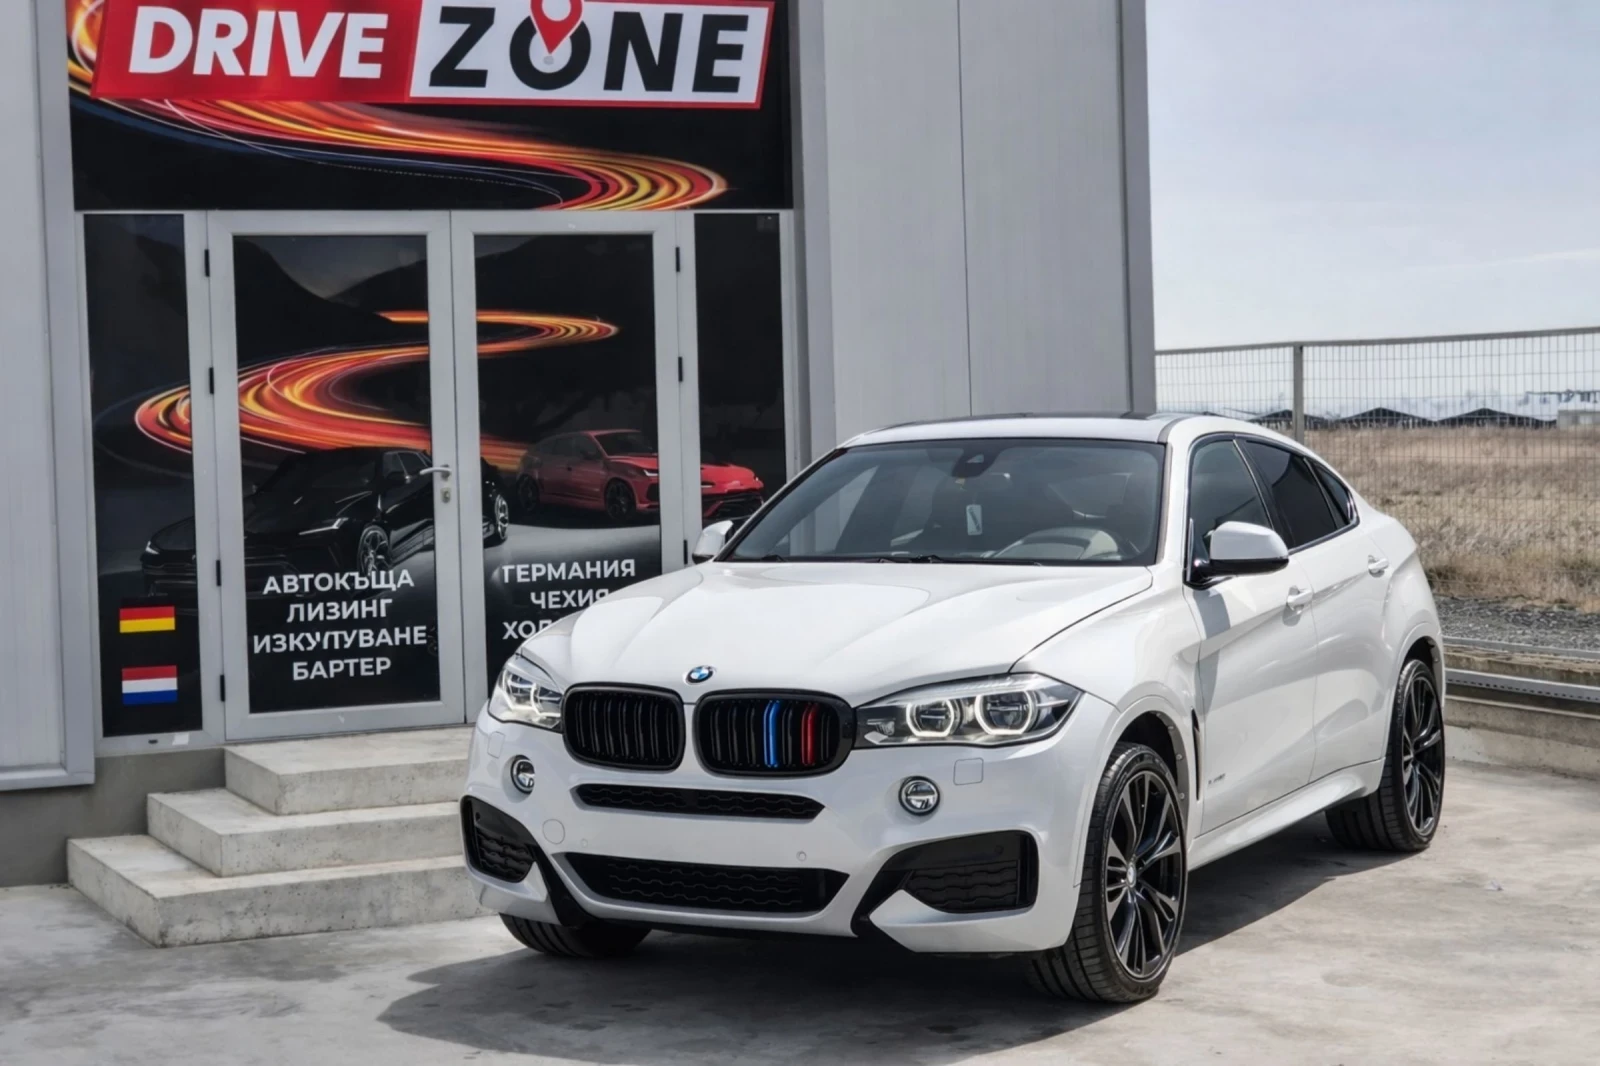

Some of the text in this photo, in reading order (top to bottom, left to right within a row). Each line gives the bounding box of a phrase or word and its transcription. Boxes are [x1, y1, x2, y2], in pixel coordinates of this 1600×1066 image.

[128, 5, 750, 93] DRIVE ZONE
[262, 569, 415, 595] АВТОКЪЩА
[501, 558, 636, 583] ГЕРМАНИЯ
[286, 598, 393, 623] ЛИЗИНГ
[253, 625, 428, 654] ИЗКУПУВАНЕ
[292, 656, 392, 681] БАРТЕР
